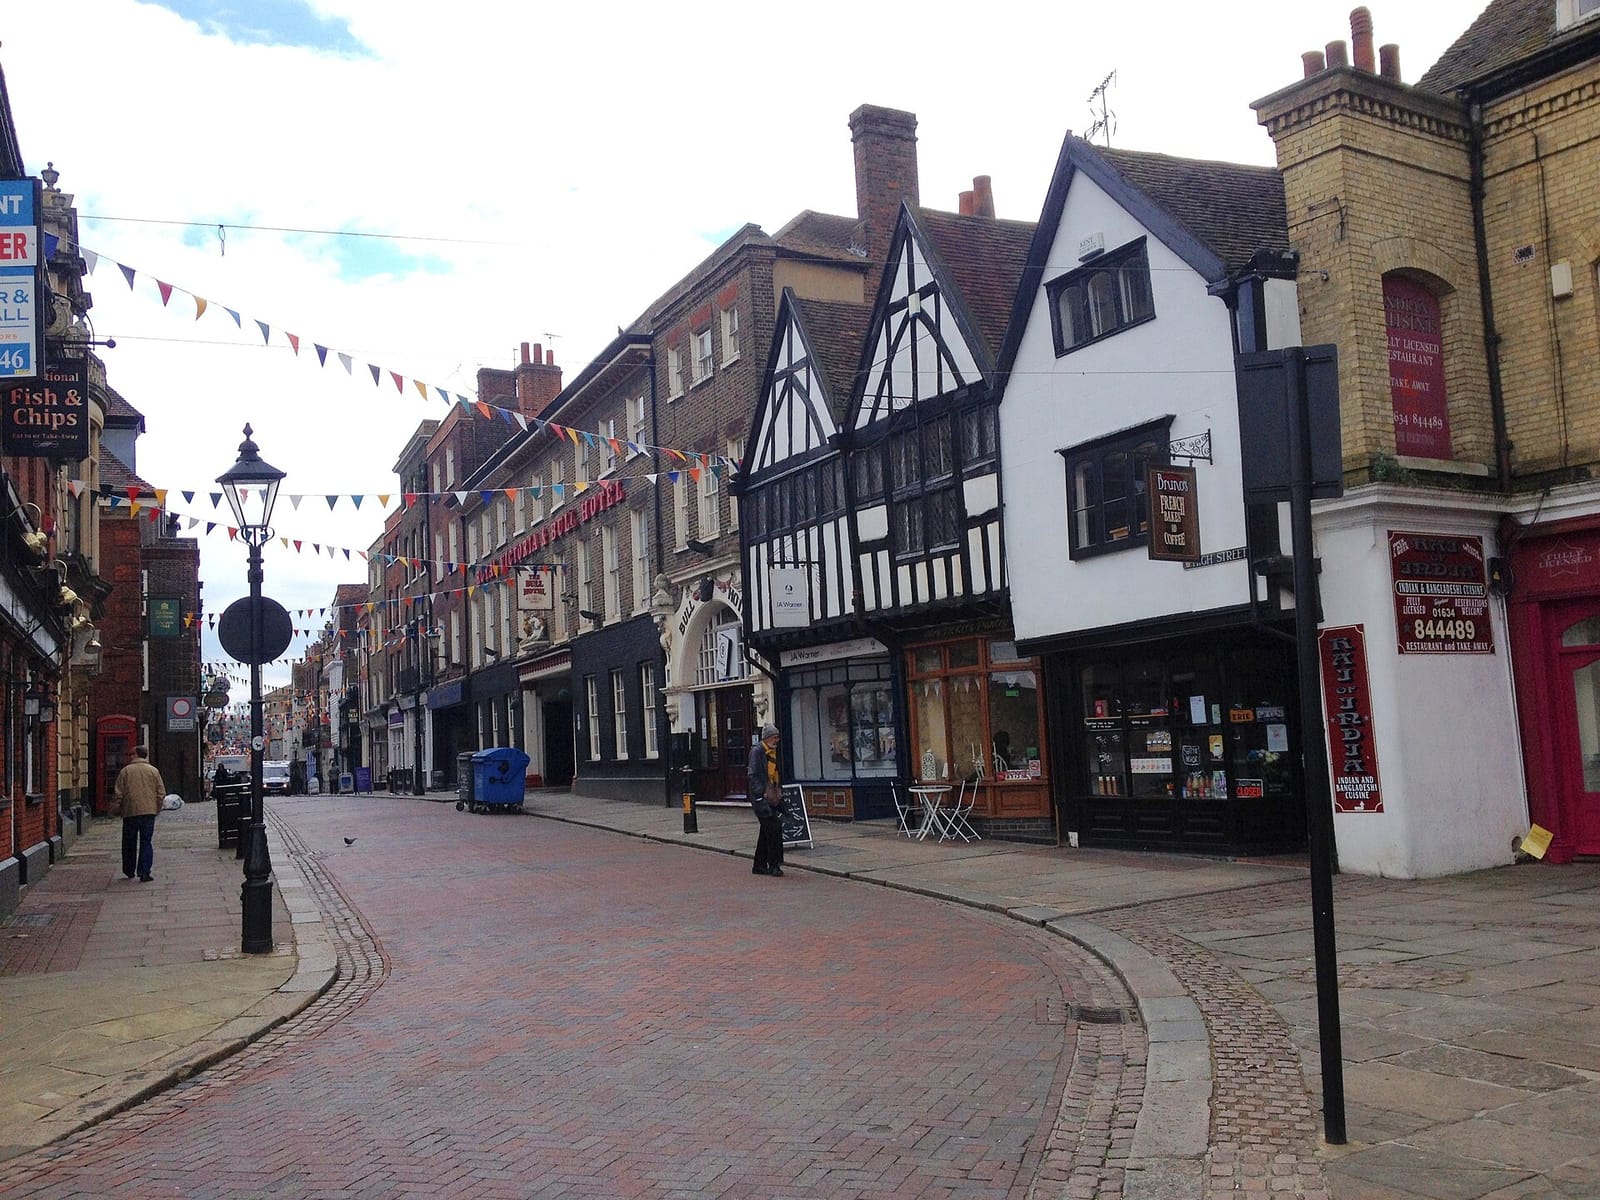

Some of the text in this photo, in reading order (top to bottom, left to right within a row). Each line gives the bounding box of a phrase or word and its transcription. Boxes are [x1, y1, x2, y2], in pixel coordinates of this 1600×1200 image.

[0, 194, 24, 214] NT
[0, 232, 28, 260] ER
[13, 289, 29, 304] &
[0, 308, 29, 321] LL
[1403, 338, 1440, 354] LICENSED
[0, 348, 24, 369] 46
[1391, 376, 1431, 391] TAKE AWAY
[10, 387, 84, 406] Fish &
[13, 407, 78, 431] Chips
[1412, 413, 1443, 430] 844489
[1160, 494, 1186, 516] FRENCH
[1163, 510, 1182, 522] BAKES
[500, 535, 539, 568] VICTORIA
[550, 509, 579, 541] BULL
[580, 480, 626, 523] HOTEL
[1163, 532, 1186, 546] COFFEE
[1216, 547, 1247, 564] STREET
[1398, 582, 1484, 596] INDIAN & BANGLADESHI CUISINE
[1406, 597, 1421, 606] FULLY
[1455, 598, 1488, 607] RESERVATIONS
[1403, 605, 1426, 615] LICENSED
[1432, 607, 1456, 618] 01634
[1461, 607, 1483, 616] WELCOME
[679, 600, 695, 635] BULL
[1414, 619, 1476, 640] 844489
[1406, 641, 1443, 651] RESTAURANT
[1444, 641, 1455, 651] and
[1232, 713, 1251, 721] ERIC
[1336, 697, 1365, 773] INDIA
[1336, 783, 1378, 792] BANGLADESHI
[1338, 776, 1374, 785] INDIAN AND
[1236, 786, 1262, 797] CLOSED
[1345, 791, 1370, 800] CUISINE
